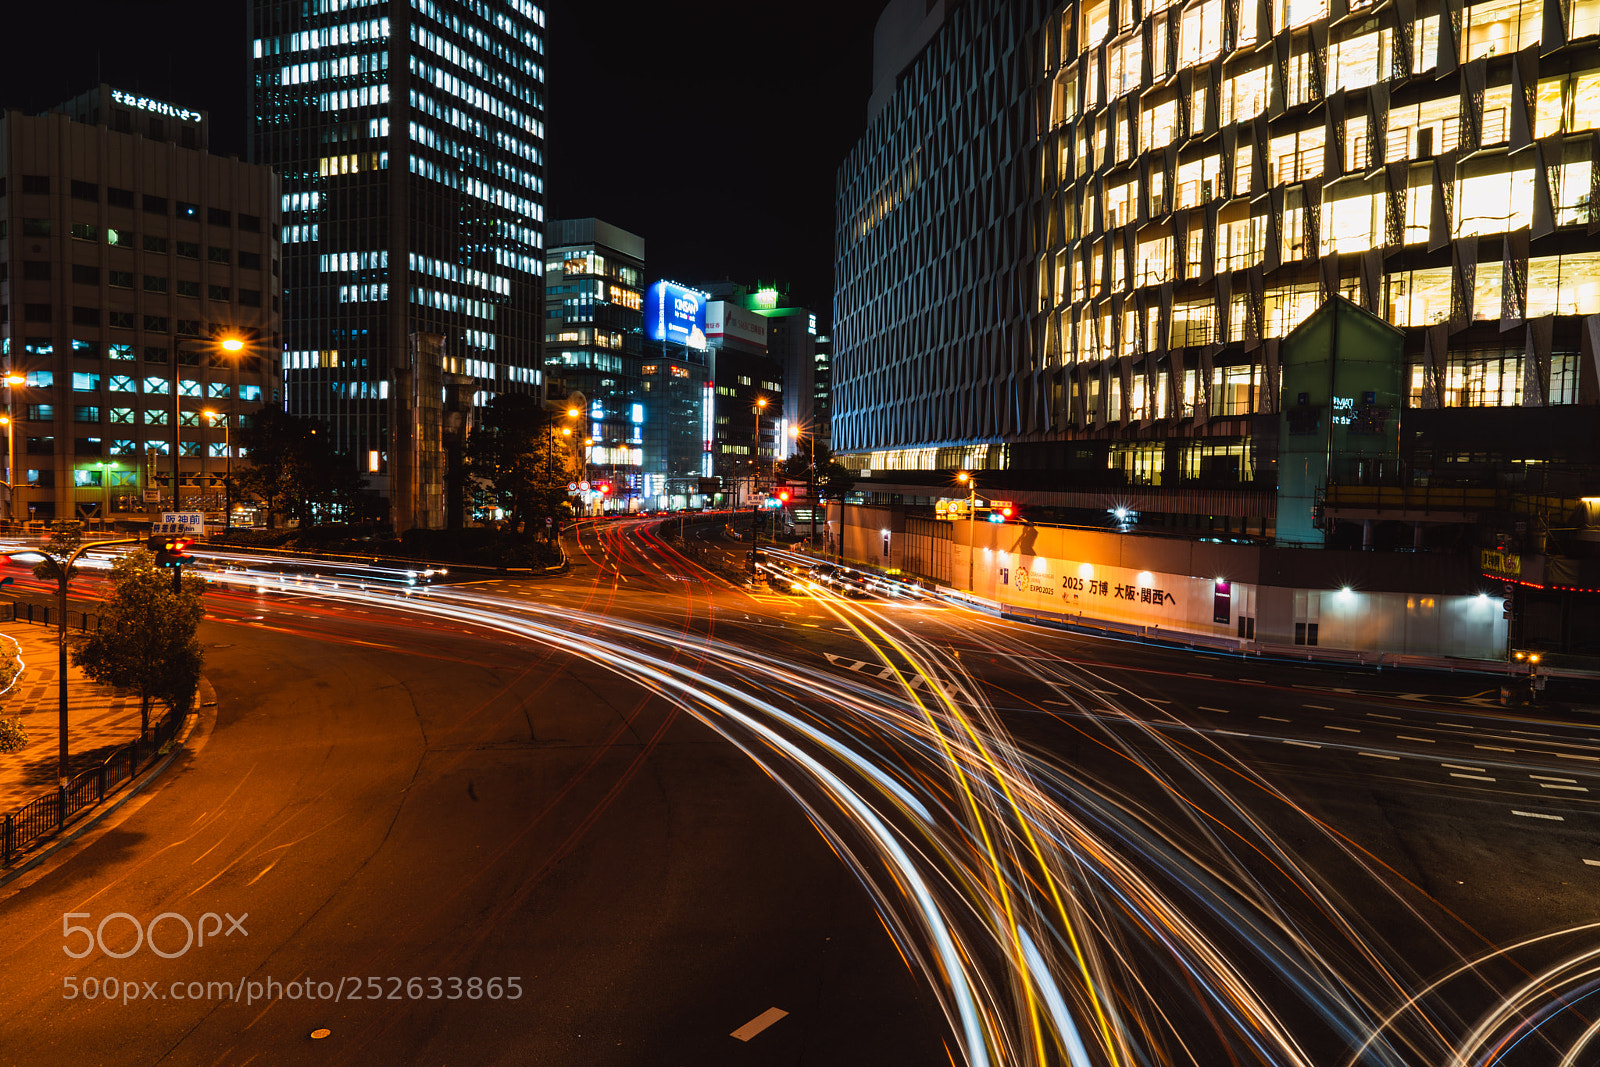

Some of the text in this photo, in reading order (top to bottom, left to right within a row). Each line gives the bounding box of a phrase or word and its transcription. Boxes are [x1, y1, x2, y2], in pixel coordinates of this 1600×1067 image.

[111, 89, 202, 123] そねざきけいさつ
[165, 514, 200, 525] 阪神前
[1062, 575, 1084, 591] 2025
[1088, 579, 1109, 596] 万博
